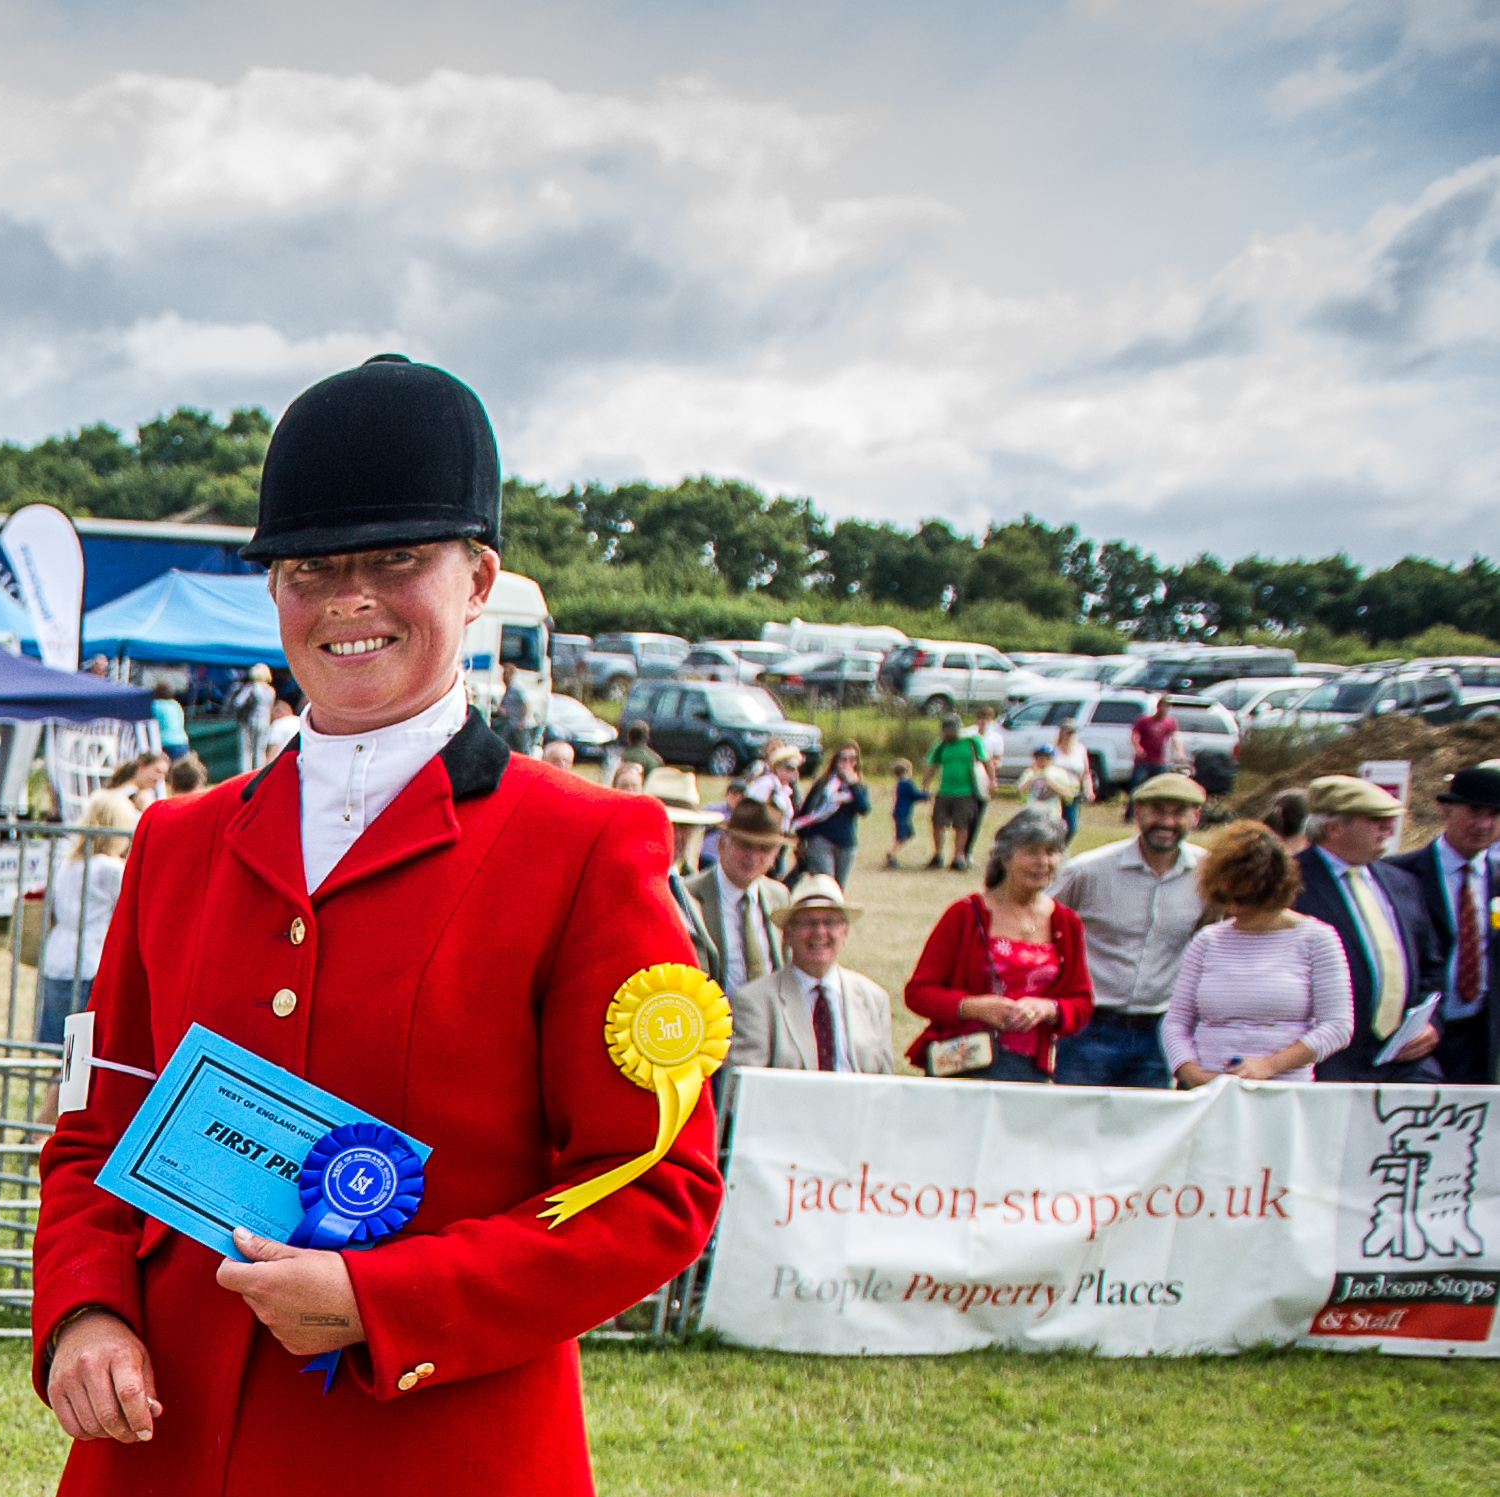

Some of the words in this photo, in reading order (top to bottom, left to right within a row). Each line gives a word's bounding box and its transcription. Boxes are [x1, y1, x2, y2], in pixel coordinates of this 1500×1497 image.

[655, 1015, 683, 1041] 3rd
[218, 1086, 242, 1103] WEST
[243, 1099, 256, 1110] OF
[256, 1107, 297, 1133] ENGLAND
[297, 1129, 320, 1143] HOU
[204, 1120, 269, 1163] FIRST
[264, 1153, 302, 1184] PRI
[348, 1167, 374, 1195] 1st
[772, 1265, 893, 1314] People
[901, 1272, 1066, 1319] Property
[1070, 1267, 1184, 1306] Places
[1340, 1273, 1497, 1304] Jackson-Stops
[1317, 1309, 1346, 1331] &
[1349, 1307, 1410, 1331] Staff
